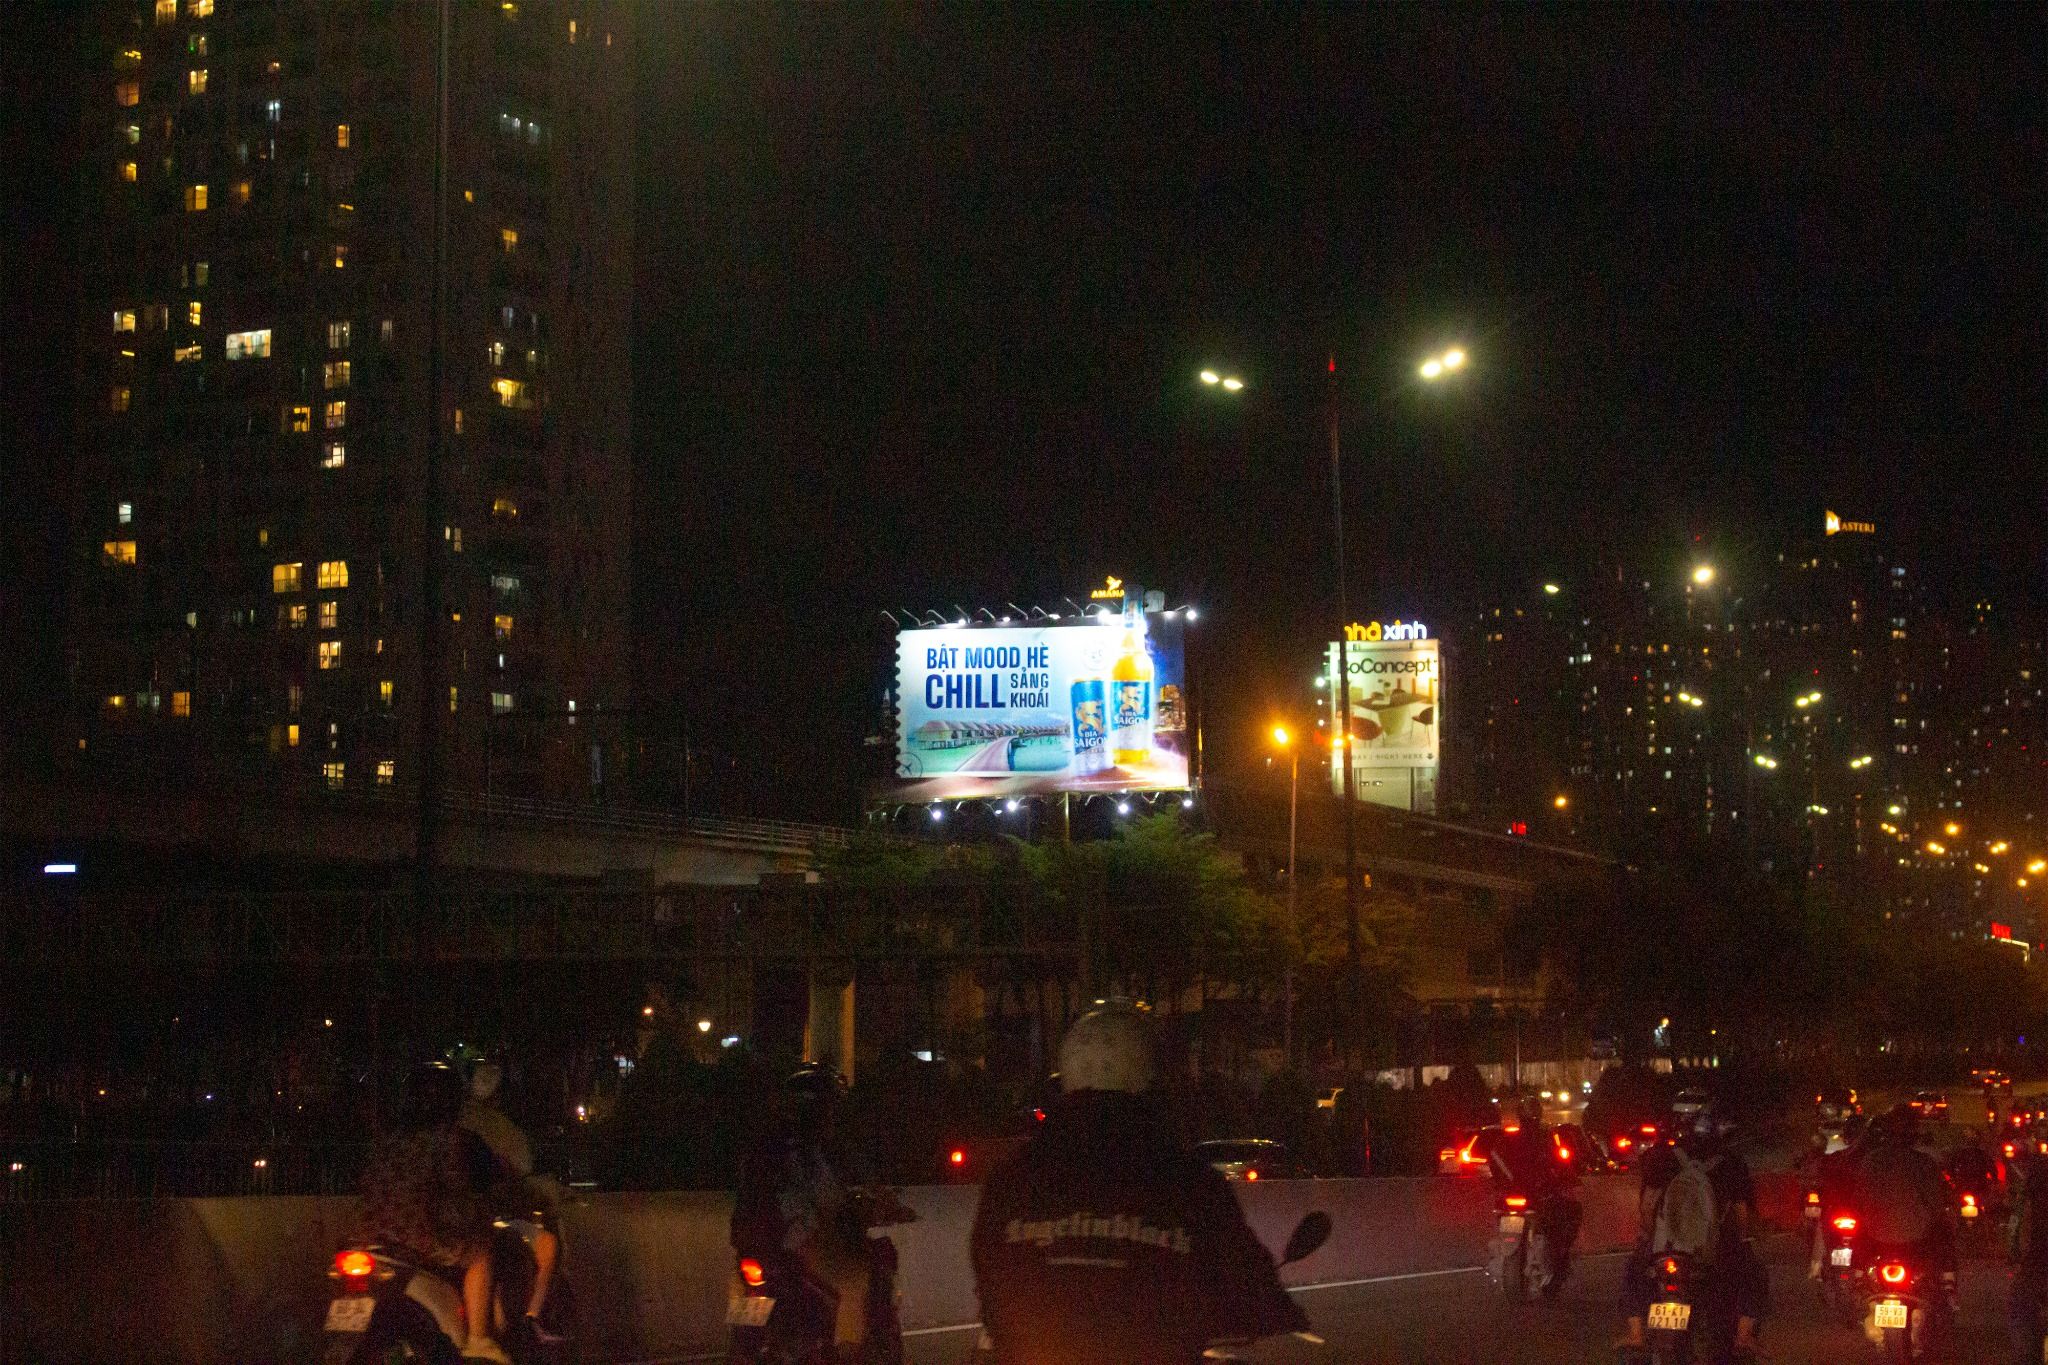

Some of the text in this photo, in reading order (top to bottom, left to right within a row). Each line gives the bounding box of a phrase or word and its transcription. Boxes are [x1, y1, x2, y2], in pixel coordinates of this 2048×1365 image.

[1383, 619, 1427, 640] xinh
[926, 641, 1049, 673] BẬT MOOD HÈ
[1338, 657, 1431, 677] oConcept
[1010, 666, 1049, 689] SẢNG
[925, 673, 1007, 709] CHILL
[1010, 688, 1049, 708] KHOÁI
